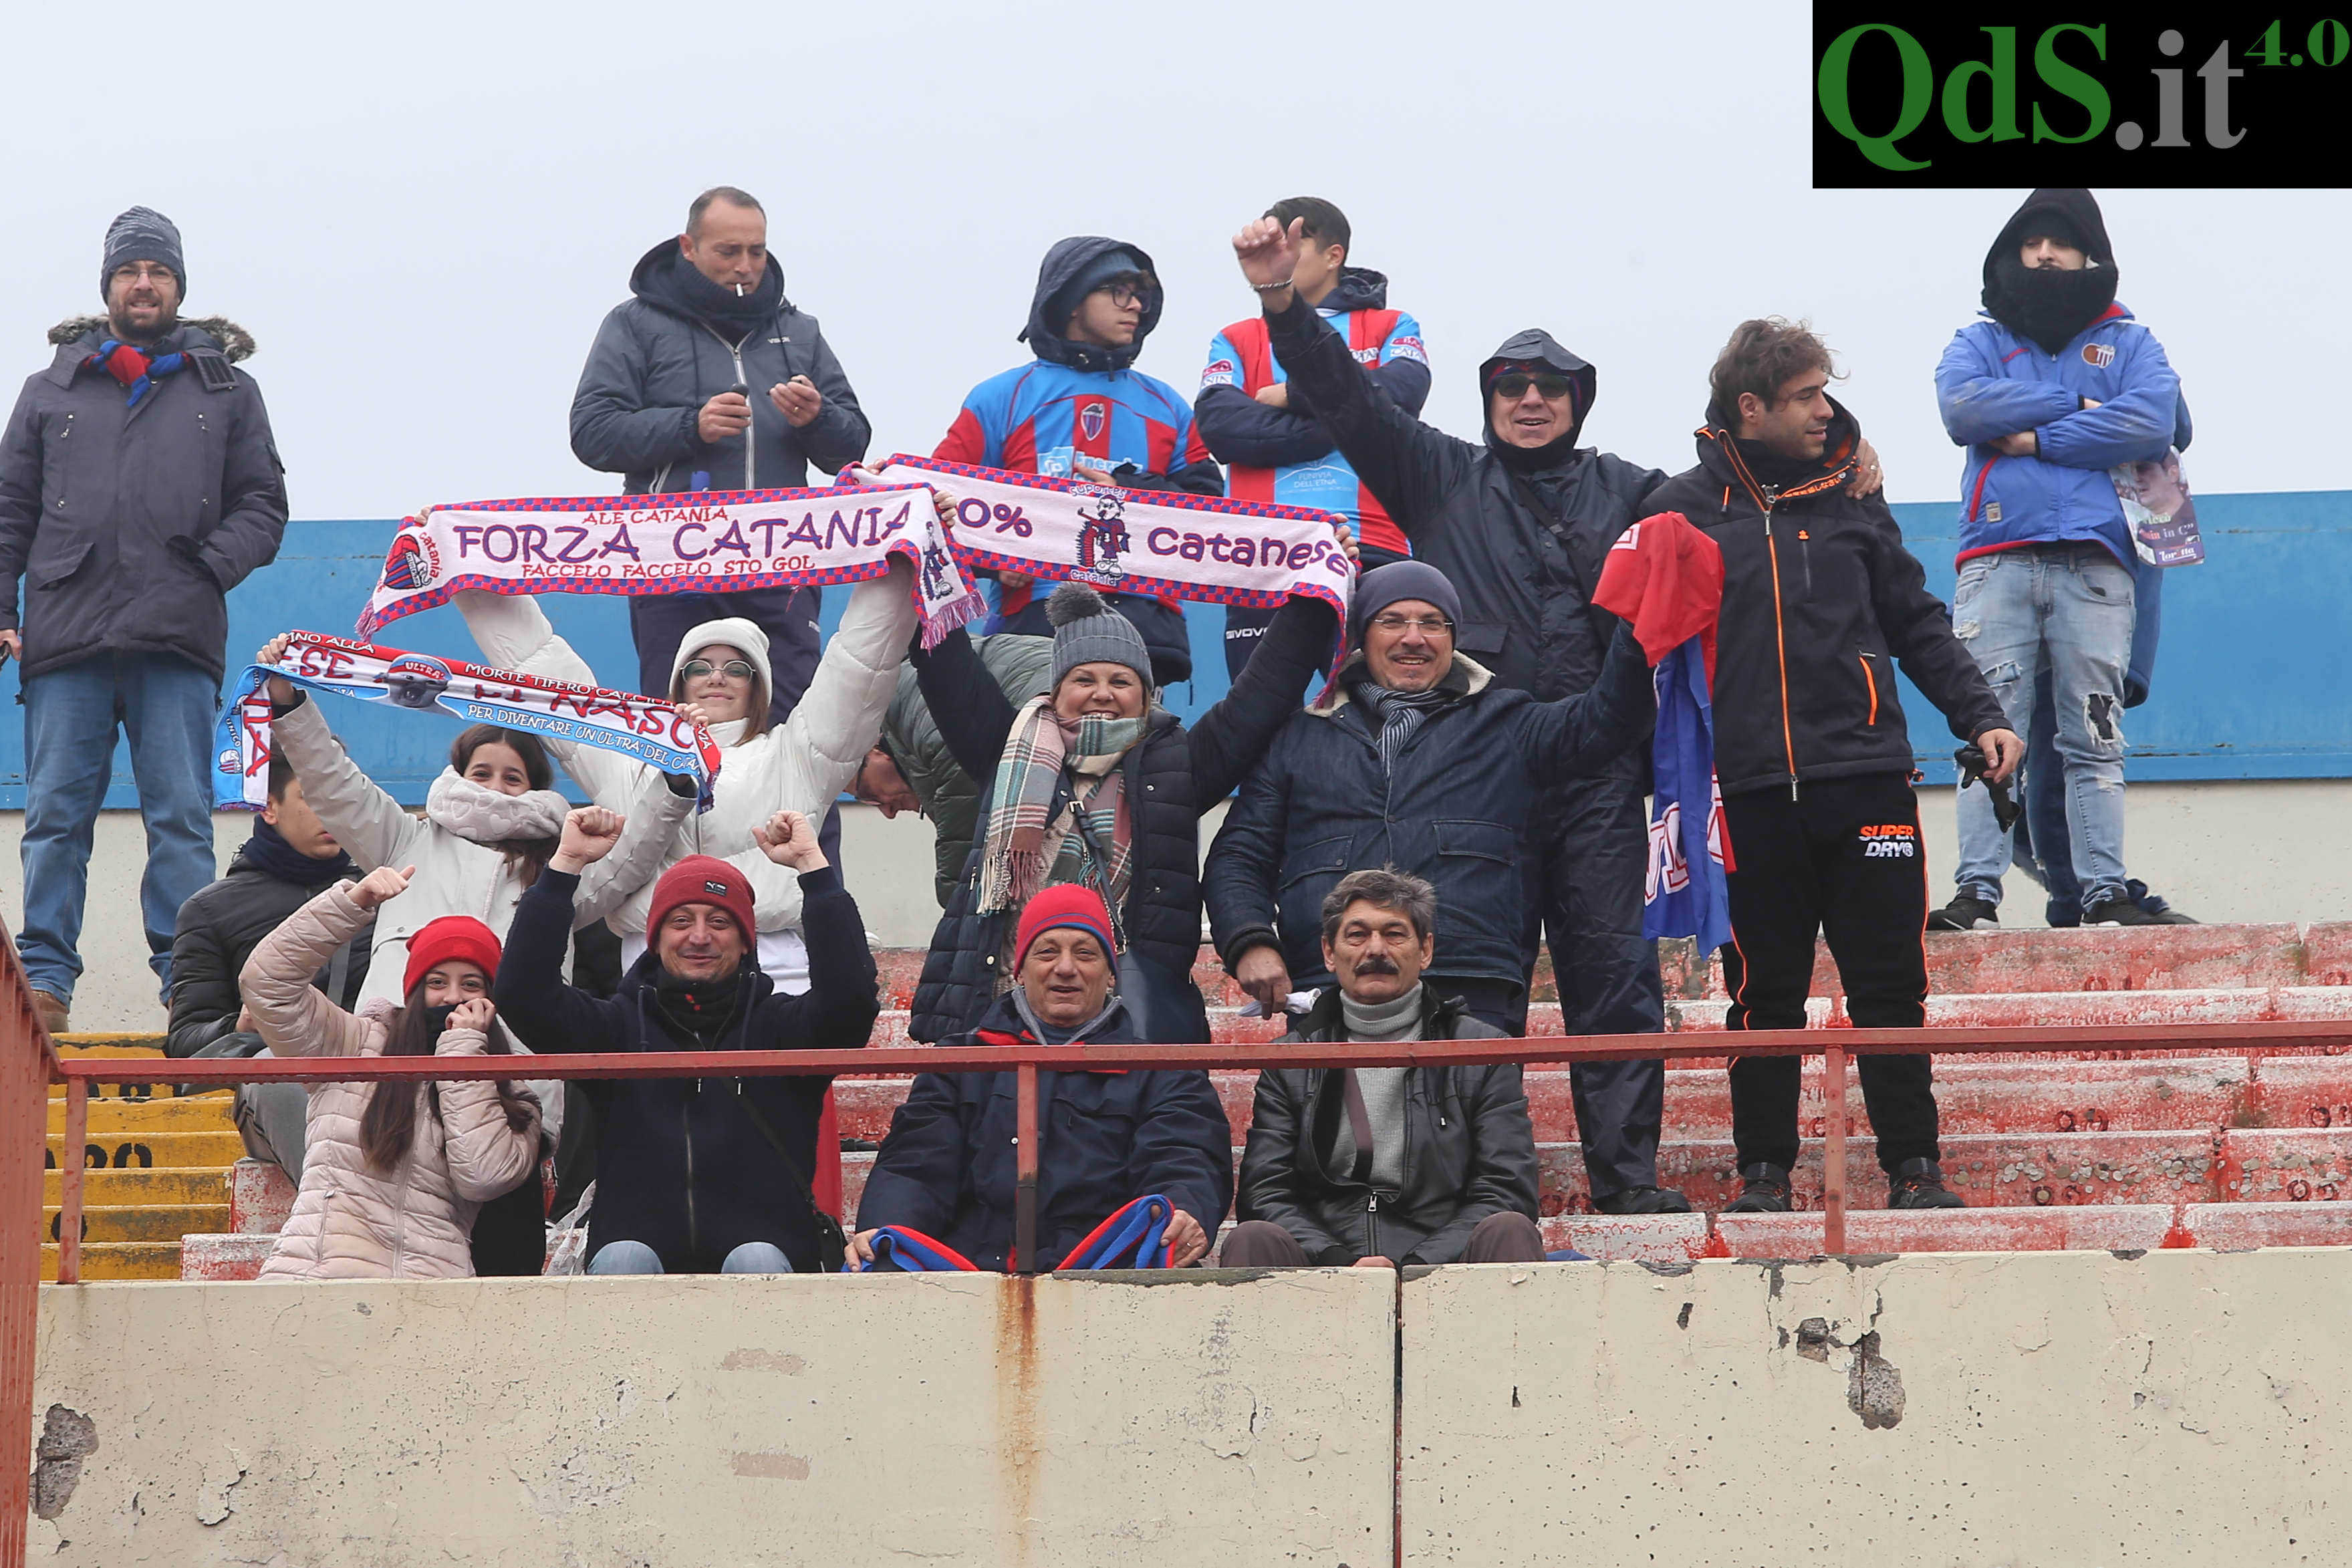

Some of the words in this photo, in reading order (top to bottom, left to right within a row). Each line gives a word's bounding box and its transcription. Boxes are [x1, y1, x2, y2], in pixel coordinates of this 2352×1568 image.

[582, 512, 625, 525] ALE
[630, 506, 729, 524] CATANIA
[453, 523, 640, 563] FORZA
[672, 501, 910, 561] CATANIA
[521, 564, 611, 578] FACCELO
[622, 561, 711, 578] FACCELO
[724, 559, 762, 575] STO
[772, 555, 815, 571] GOL
[325, 637, 374, 654] ALLA
[465, 663, 527, 683] MORTE
[225, 716, 242, 747] UNICO
[467, 704, 493, 721] PER
[497, 707, 573, 736] DIVENTARE
[575, 725, 596, 742] UN
[642, 745, 670, 767] DEL
[1858, 824, 1915, 841] SUPER
